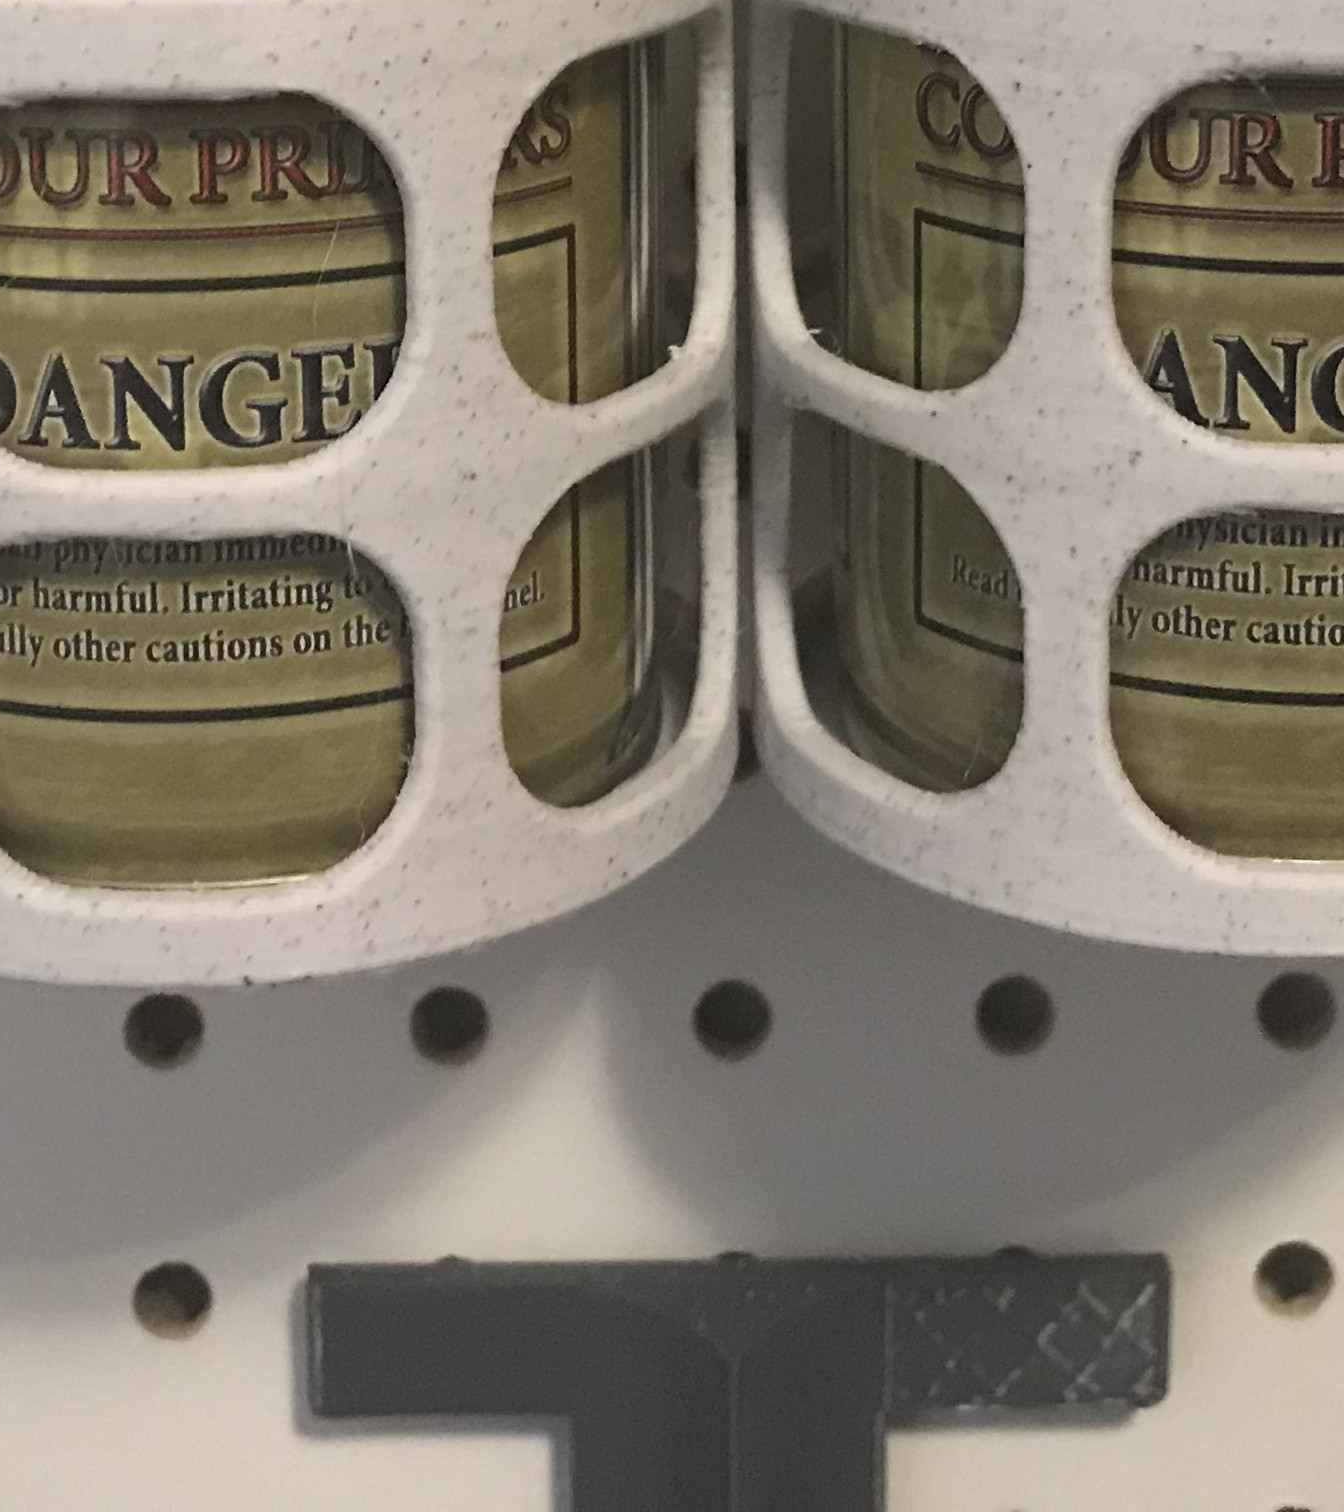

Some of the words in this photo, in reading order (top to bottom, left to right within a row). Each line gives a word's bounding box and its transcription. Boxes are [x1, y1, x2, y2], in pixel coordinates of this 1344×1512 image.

[32, 575, 168, 615] harmful.
[181, 575, 335, 614] Irritating
[52, 627, 136, 664] other
[145, 624, 284, 665] cautions
[292, 627, 333, 656] on
[342, 614, 391, 646] the
[503, 569, 545, 613] nel.
[951, 553, 1009, 600] Read
[1151, 604, 1238, 642] other
